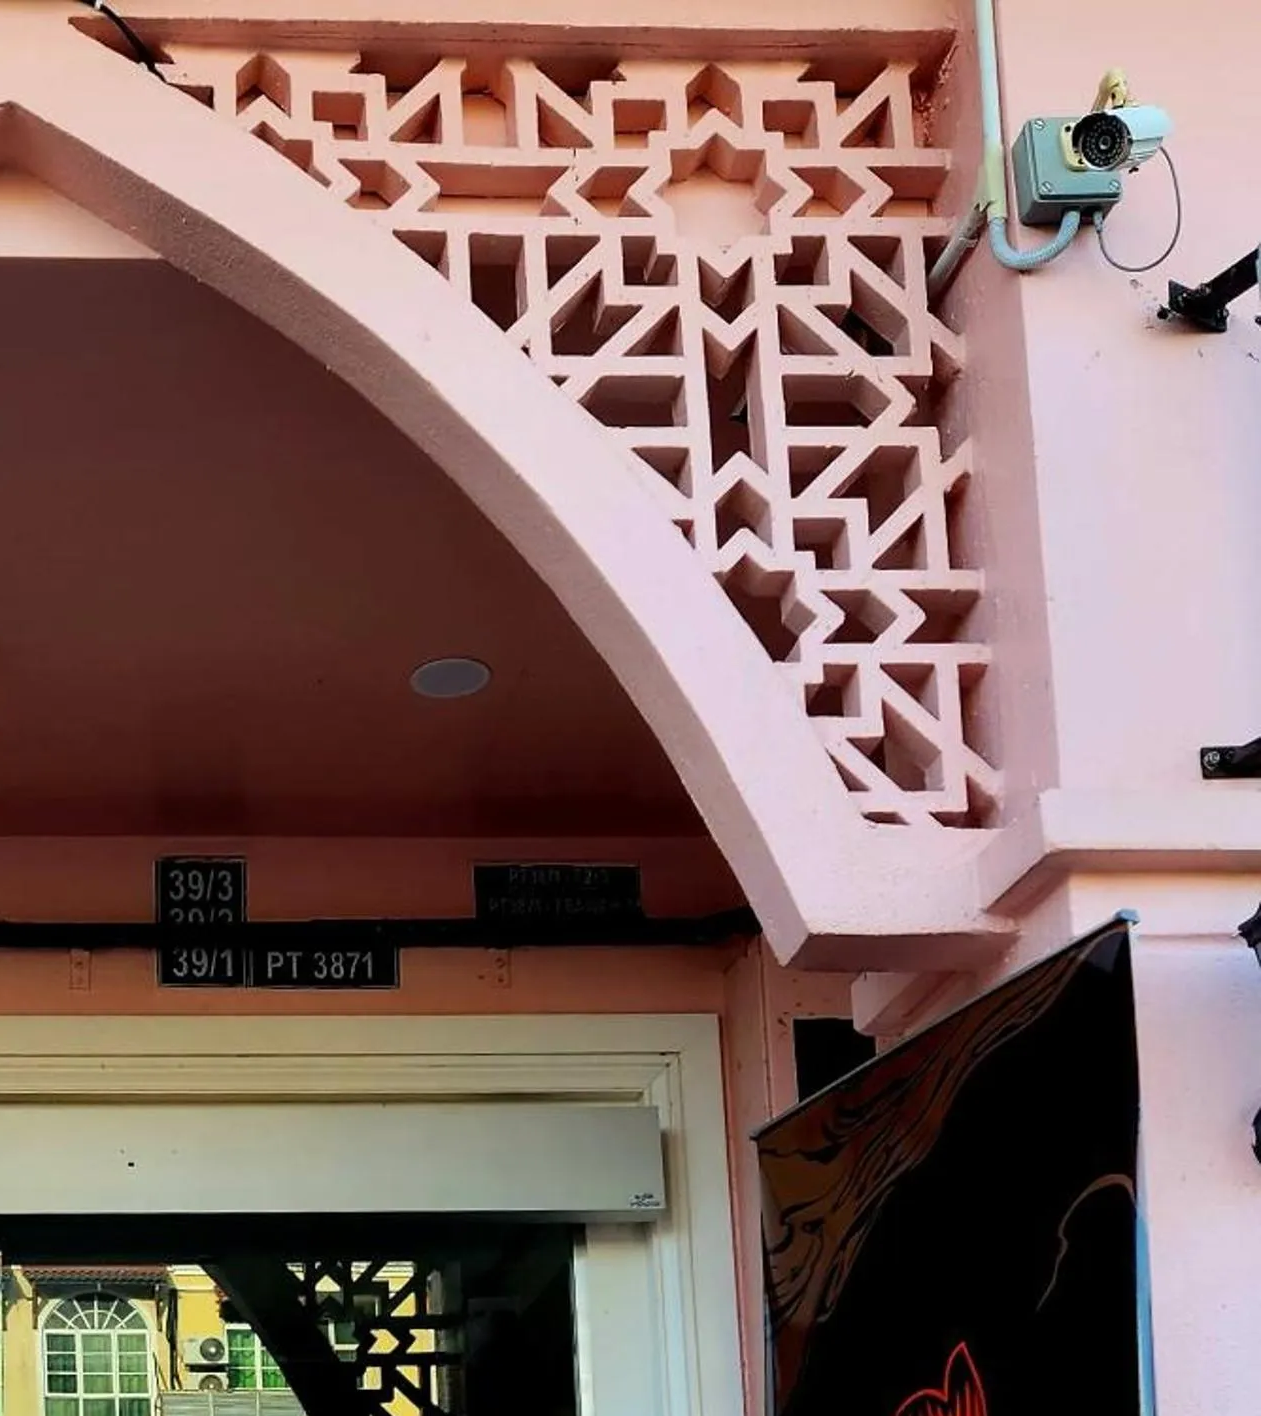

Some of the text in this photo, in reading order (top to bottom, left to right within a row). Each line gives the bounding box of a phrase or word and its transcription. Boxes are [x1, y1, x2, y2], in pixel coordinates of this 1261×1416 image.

[168, 868, 233, 901] 39/3
[172, 946, 233, 977] 39/1
[267, 951, 373, 980] PT 3871
